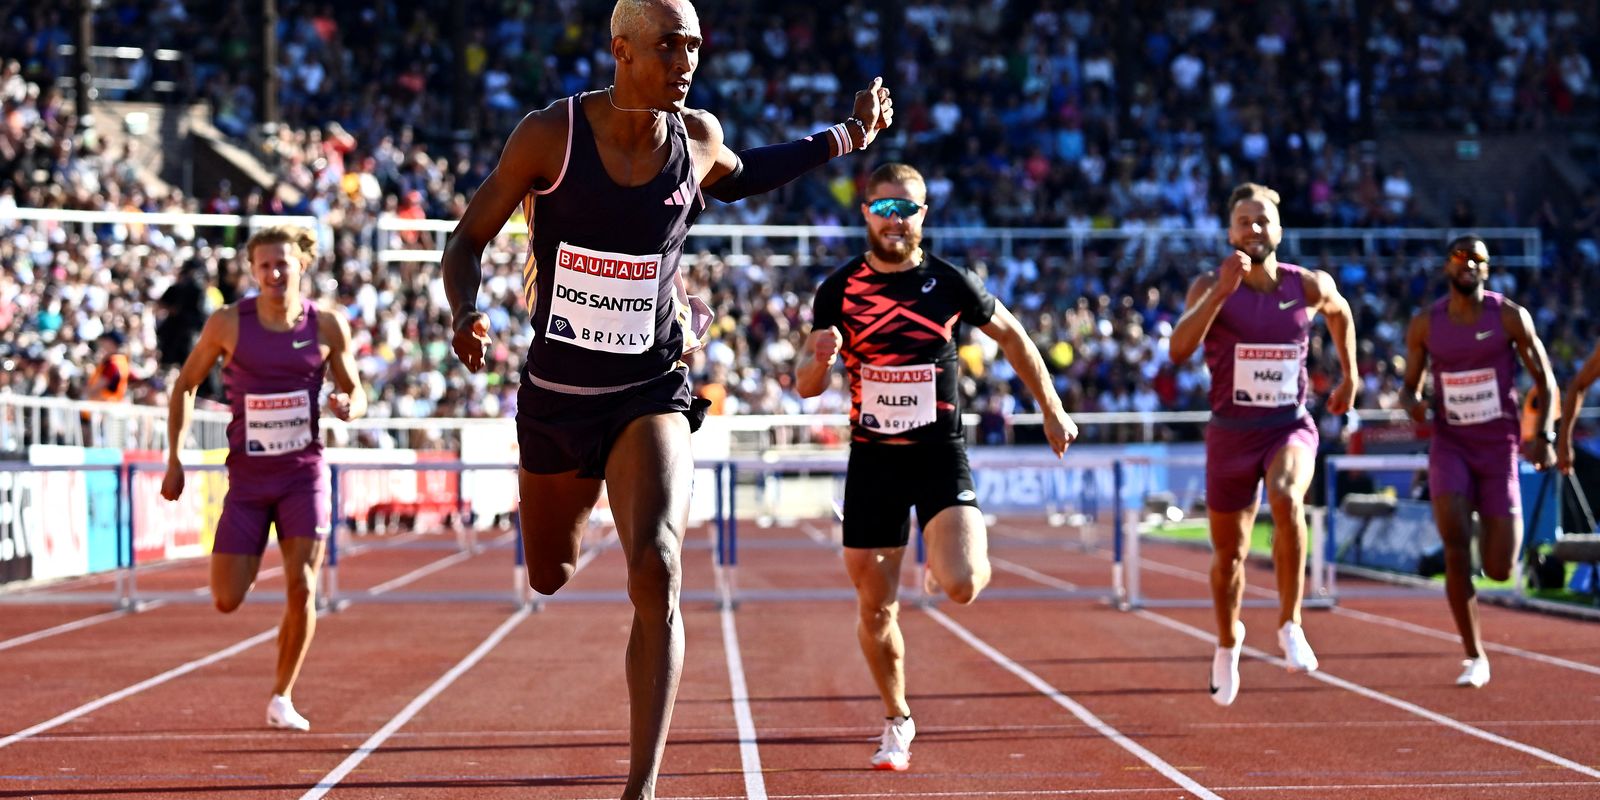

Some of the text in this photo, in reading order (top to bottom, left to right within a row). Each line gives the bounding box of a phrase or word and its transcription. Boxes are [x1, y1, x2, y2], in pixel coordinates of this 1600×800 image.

[560, 252, 657, 279] BAUHAUS
[556, 284, 654, 312] DOS SANTOS
[582, 328, 650, 346] BRIXLY
[862, 368, 932, 383] BAUHAUS
[877, 395, 918, 406] ALLEN
